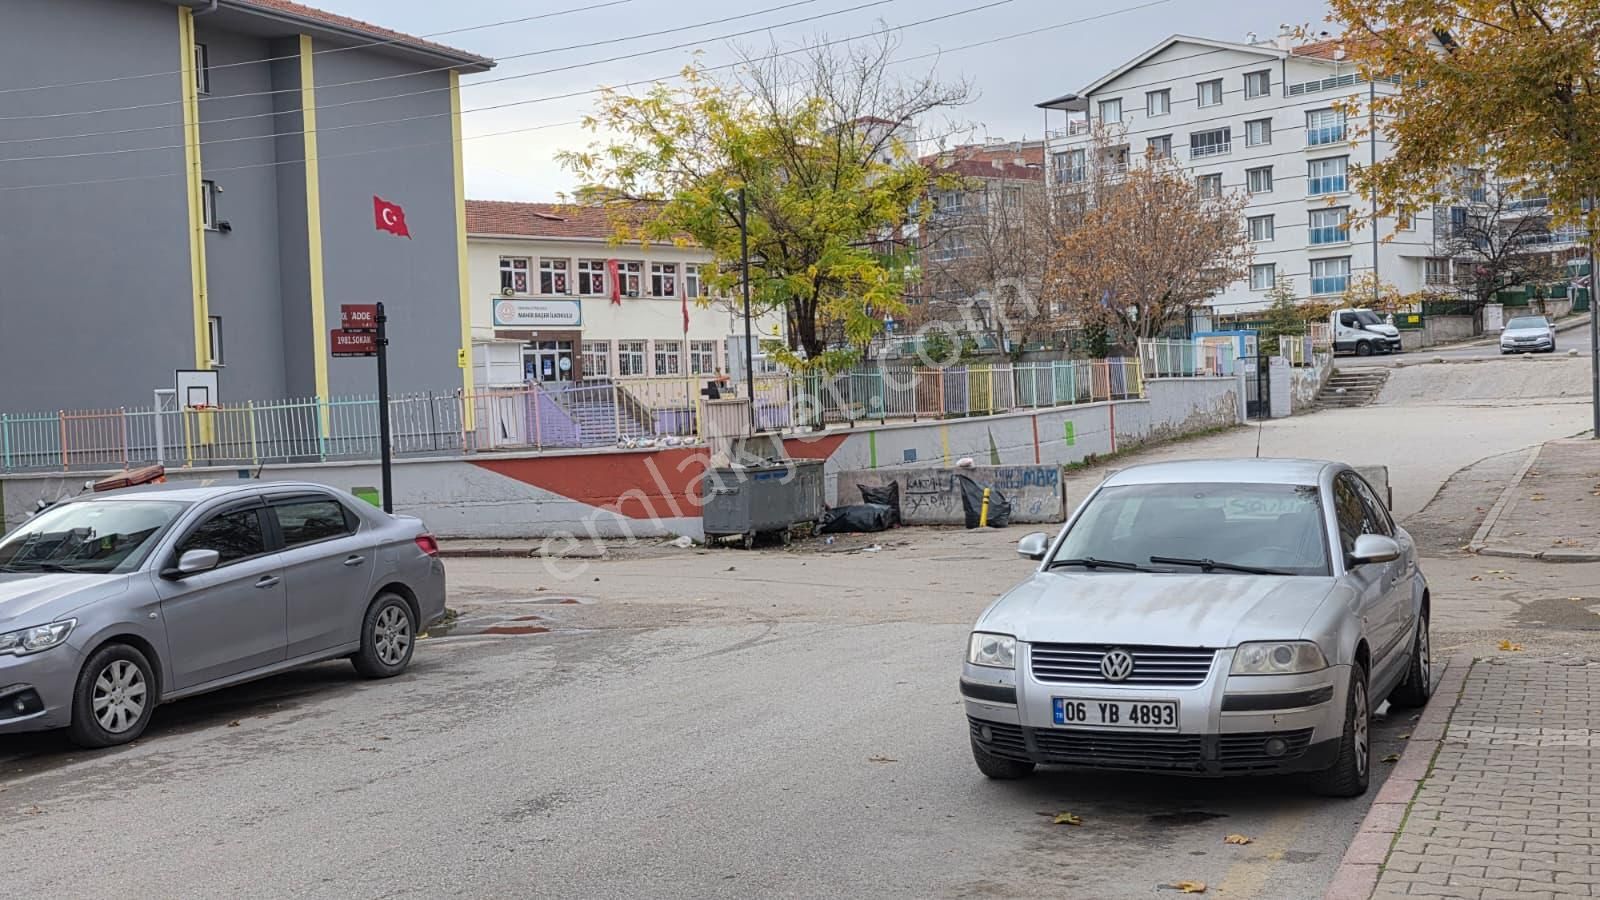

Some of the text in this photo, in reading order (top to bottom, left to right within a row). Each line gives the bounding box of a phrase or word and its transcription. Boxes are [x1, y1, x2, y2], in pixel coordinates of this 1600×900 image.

[1102, 651, 1132, 681] VW
[1065, 701, 1087, 722] 06
[1098, 703, 1120, 724] YB
[1128, 704, 1174, 725] 4893
